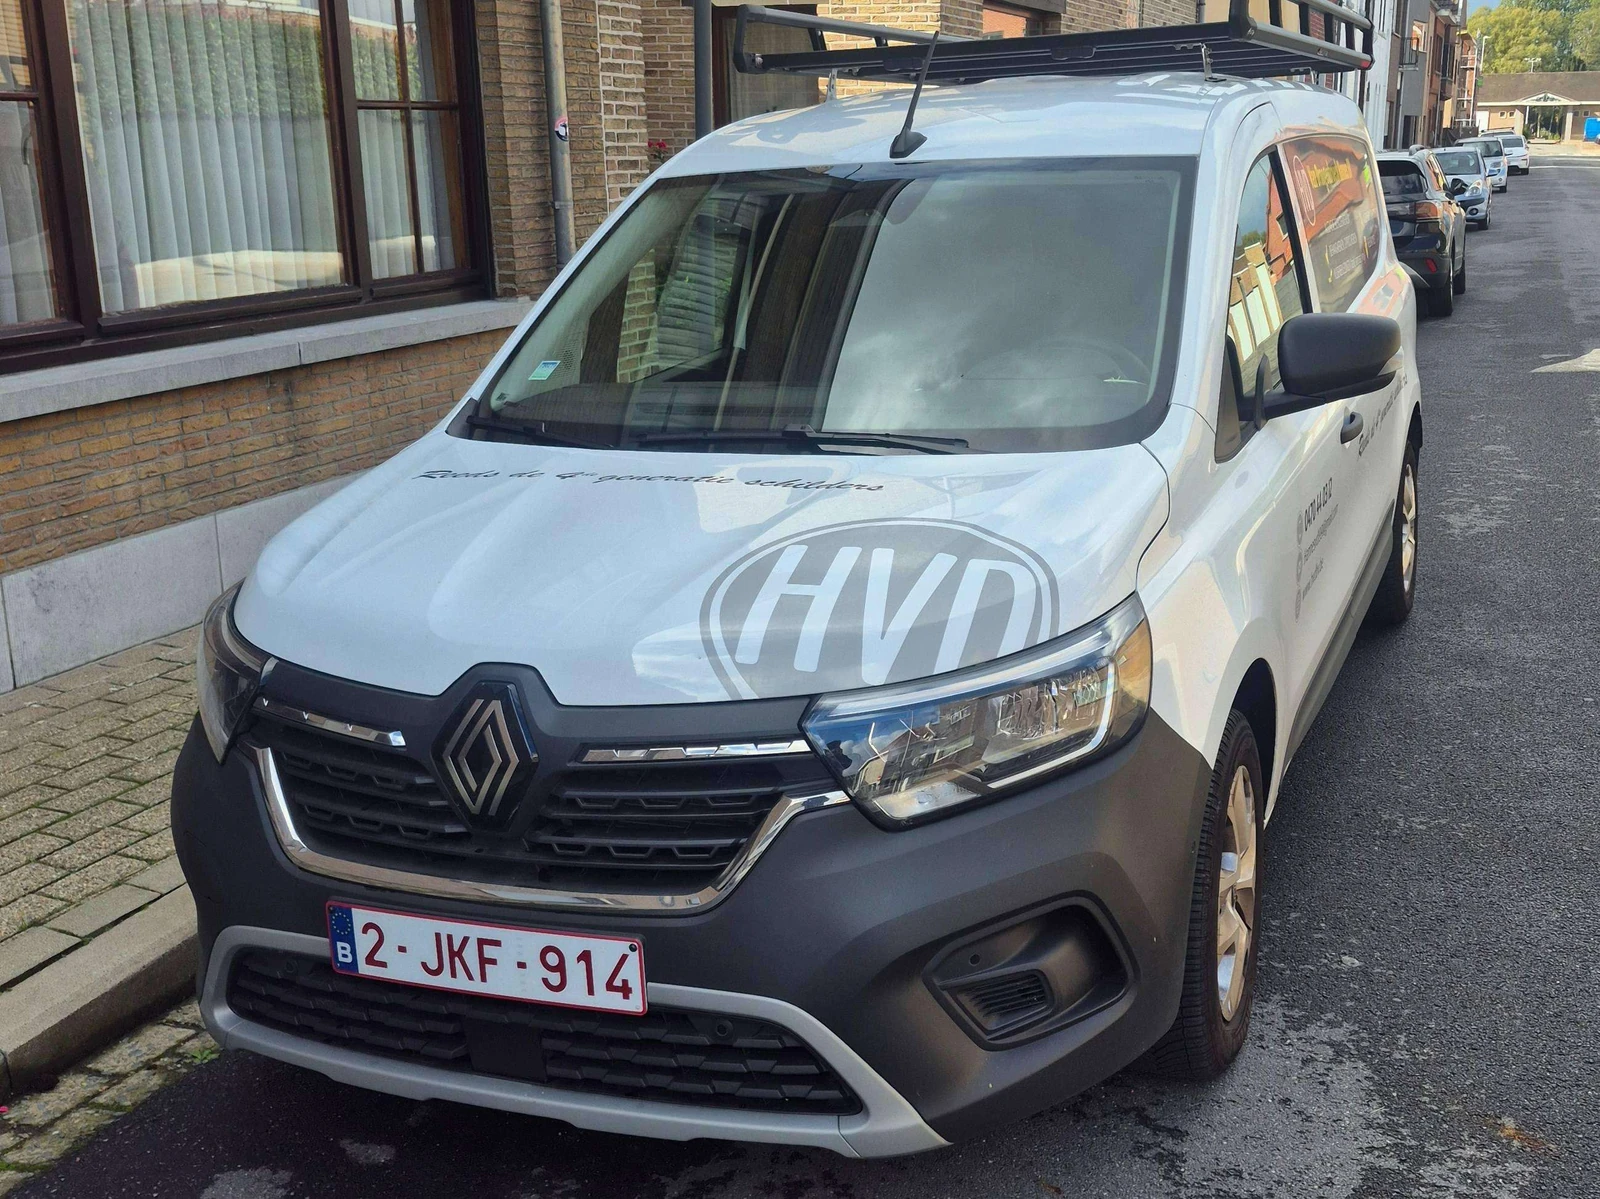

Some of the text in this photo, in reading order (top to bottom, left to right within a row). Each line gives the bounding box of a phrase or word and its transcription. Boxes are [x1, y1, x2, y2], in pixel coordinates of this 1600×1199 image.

[509, 469, 545, 479] de
[592, 474, 734, 484] generatie
[743, 477, 884, 491] schilders
[735, 544, 1037, 686] HVD
[336, 941, 353, 964] B
[361, 921, 634, 1000] 2-JKF-914
